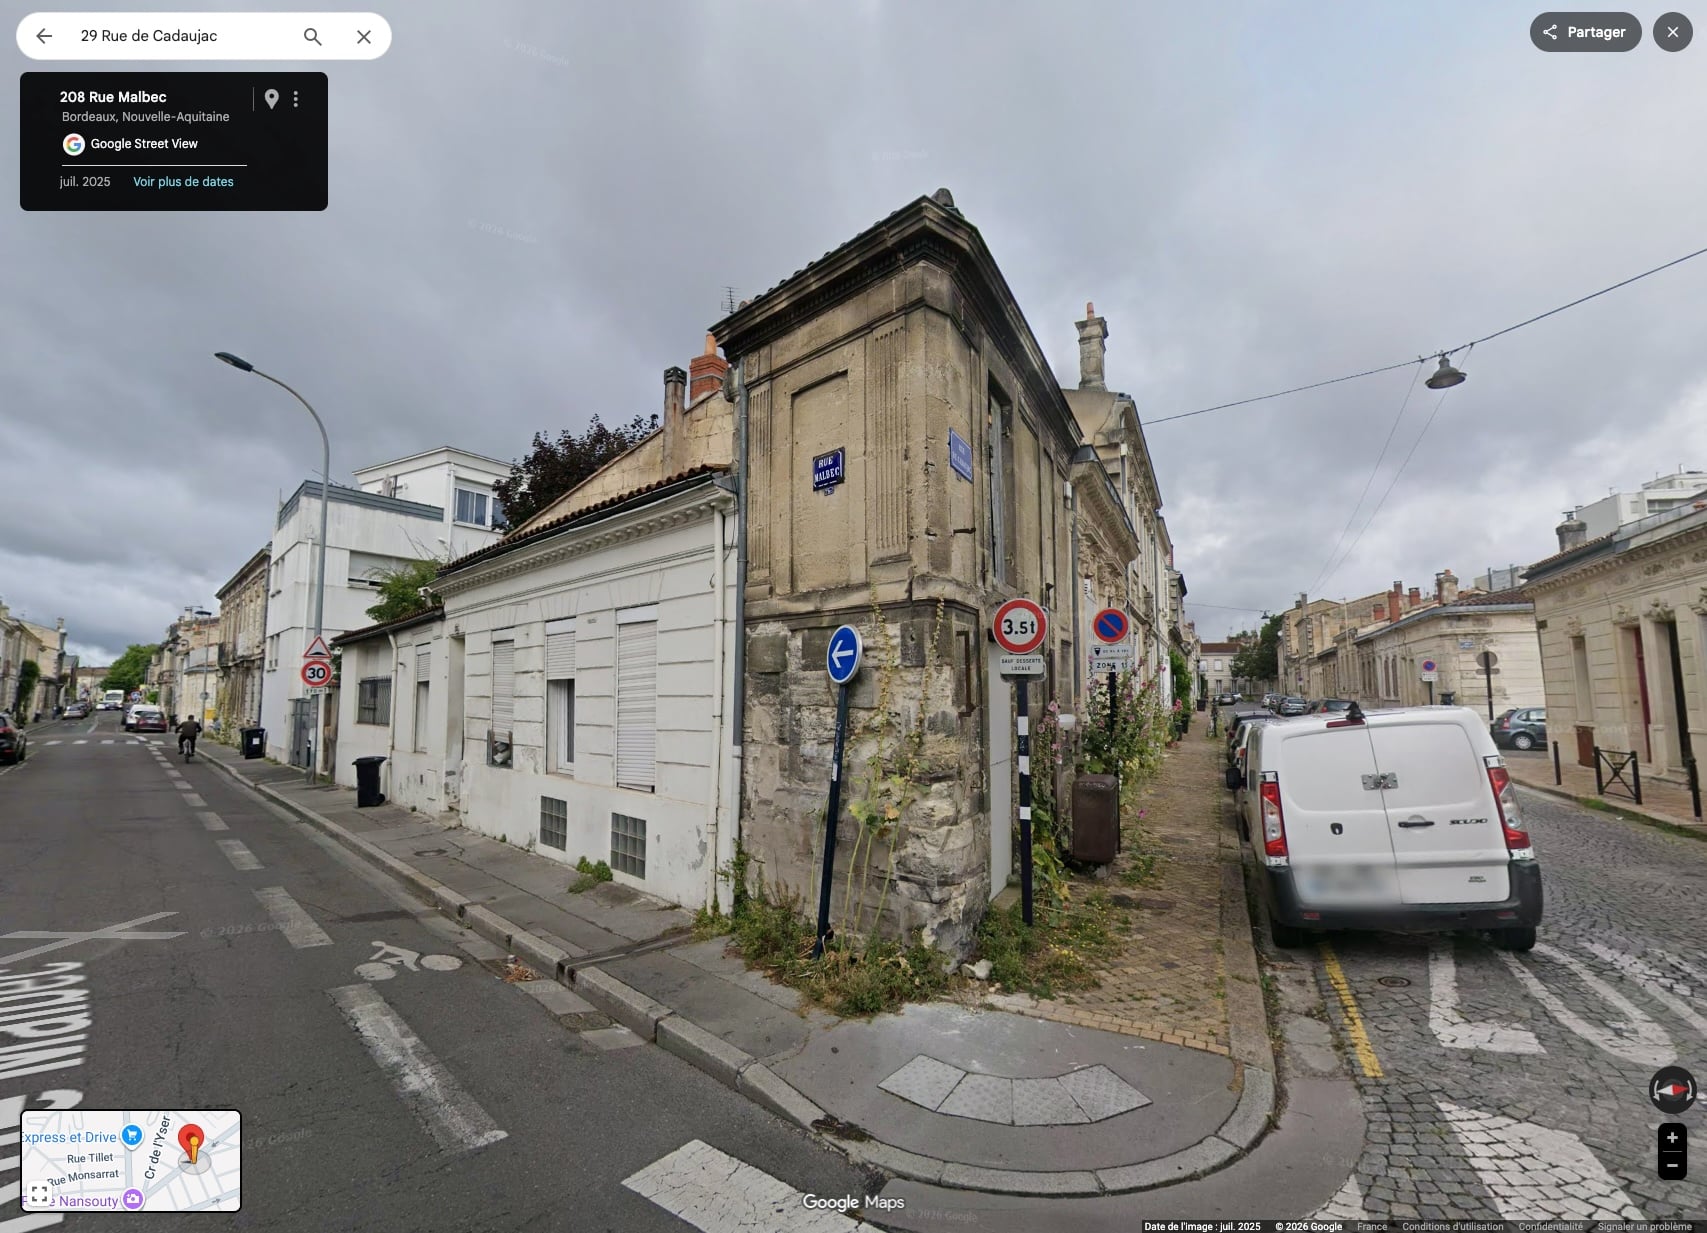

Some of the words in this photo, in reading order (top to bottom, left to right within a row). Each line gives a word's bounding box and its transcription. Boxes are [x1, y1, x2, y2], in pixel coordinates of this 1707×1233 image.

[818, 456, 834, 468] RUE
[814, 466, 840, 482] MALBEC
[307, 667, 326, 679] 30
